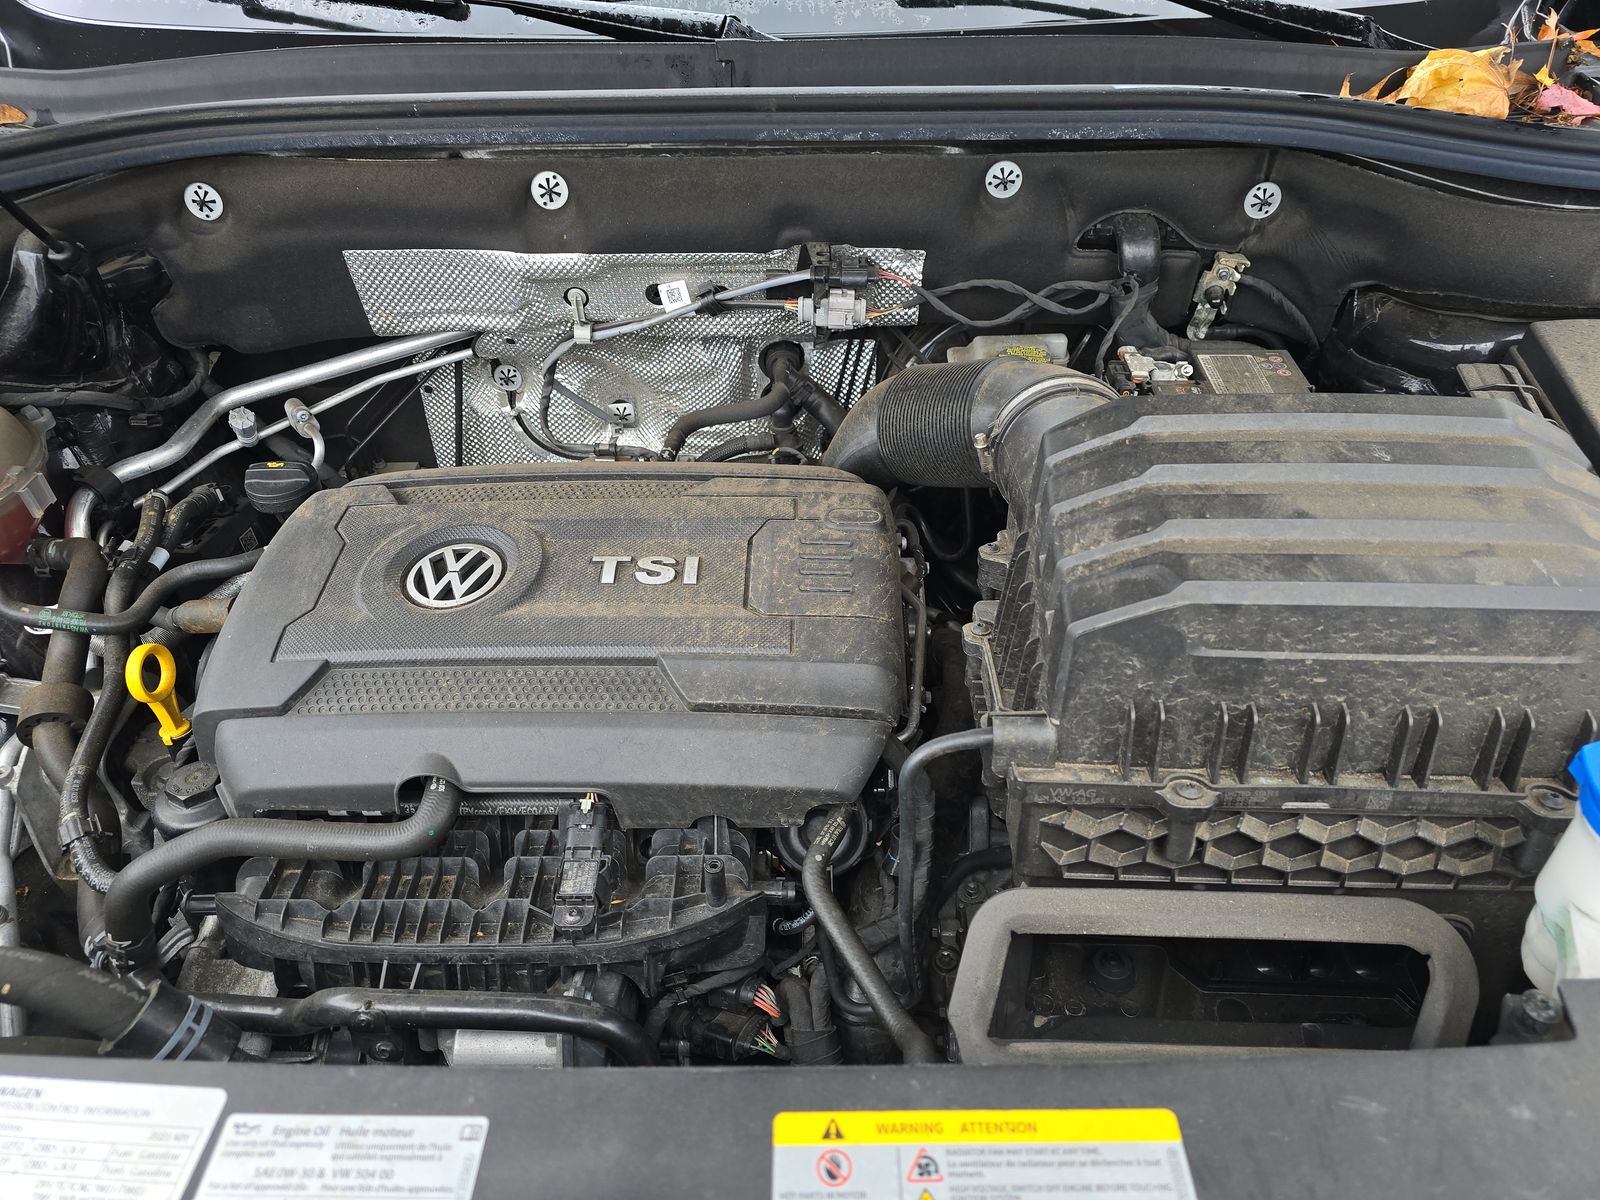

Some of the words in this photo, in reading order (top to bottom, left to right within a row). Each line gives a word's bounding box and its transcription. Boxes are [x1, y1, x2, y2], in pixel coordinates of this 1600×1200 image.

[591, 555, 701, 585] TSI
[271, 1125, 311, 1139] Engine
[313, 1125, 331, 1137] Oil
[339, 1126, 370, 1138] Huile
[372, 1127, 415, 1138] moteur
[876, 1121, 944, 1135] WARNING
[960, 1121, 1039, 1134] ATTENTION
